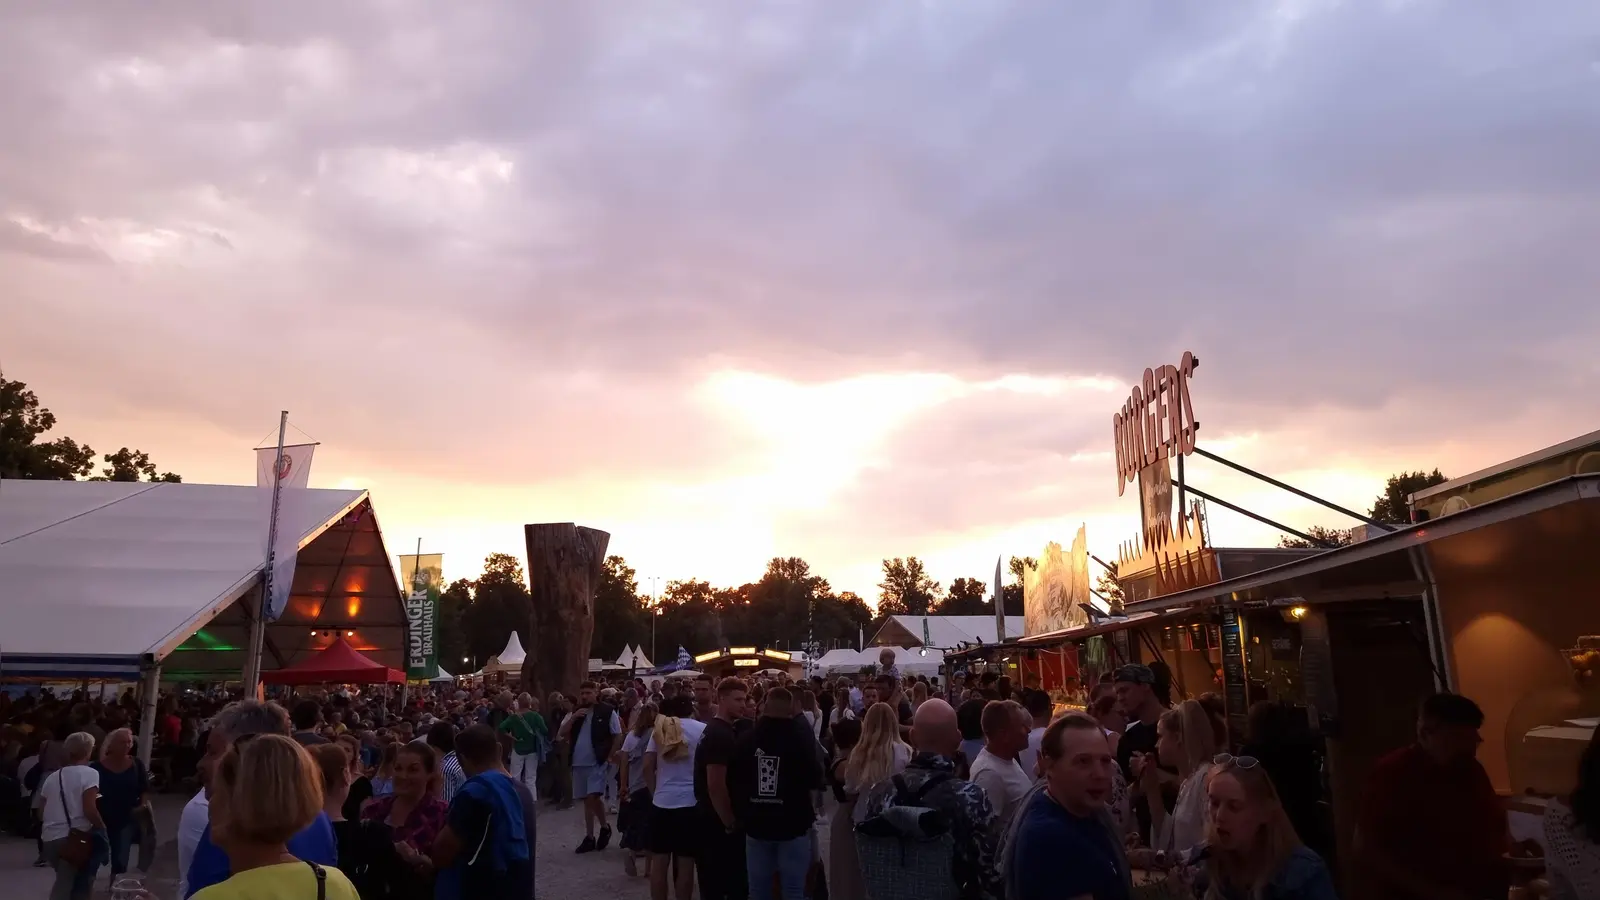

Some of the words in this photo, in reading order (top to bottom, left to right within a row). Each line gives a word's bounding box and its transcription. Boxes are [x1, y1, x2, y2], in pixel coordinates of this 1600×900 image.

[1113, 351, 1195, 497] BURGERS
[407, 588, 428, 667] ERDINGER
[423, 600, 434, 655] BRAUHAUS
